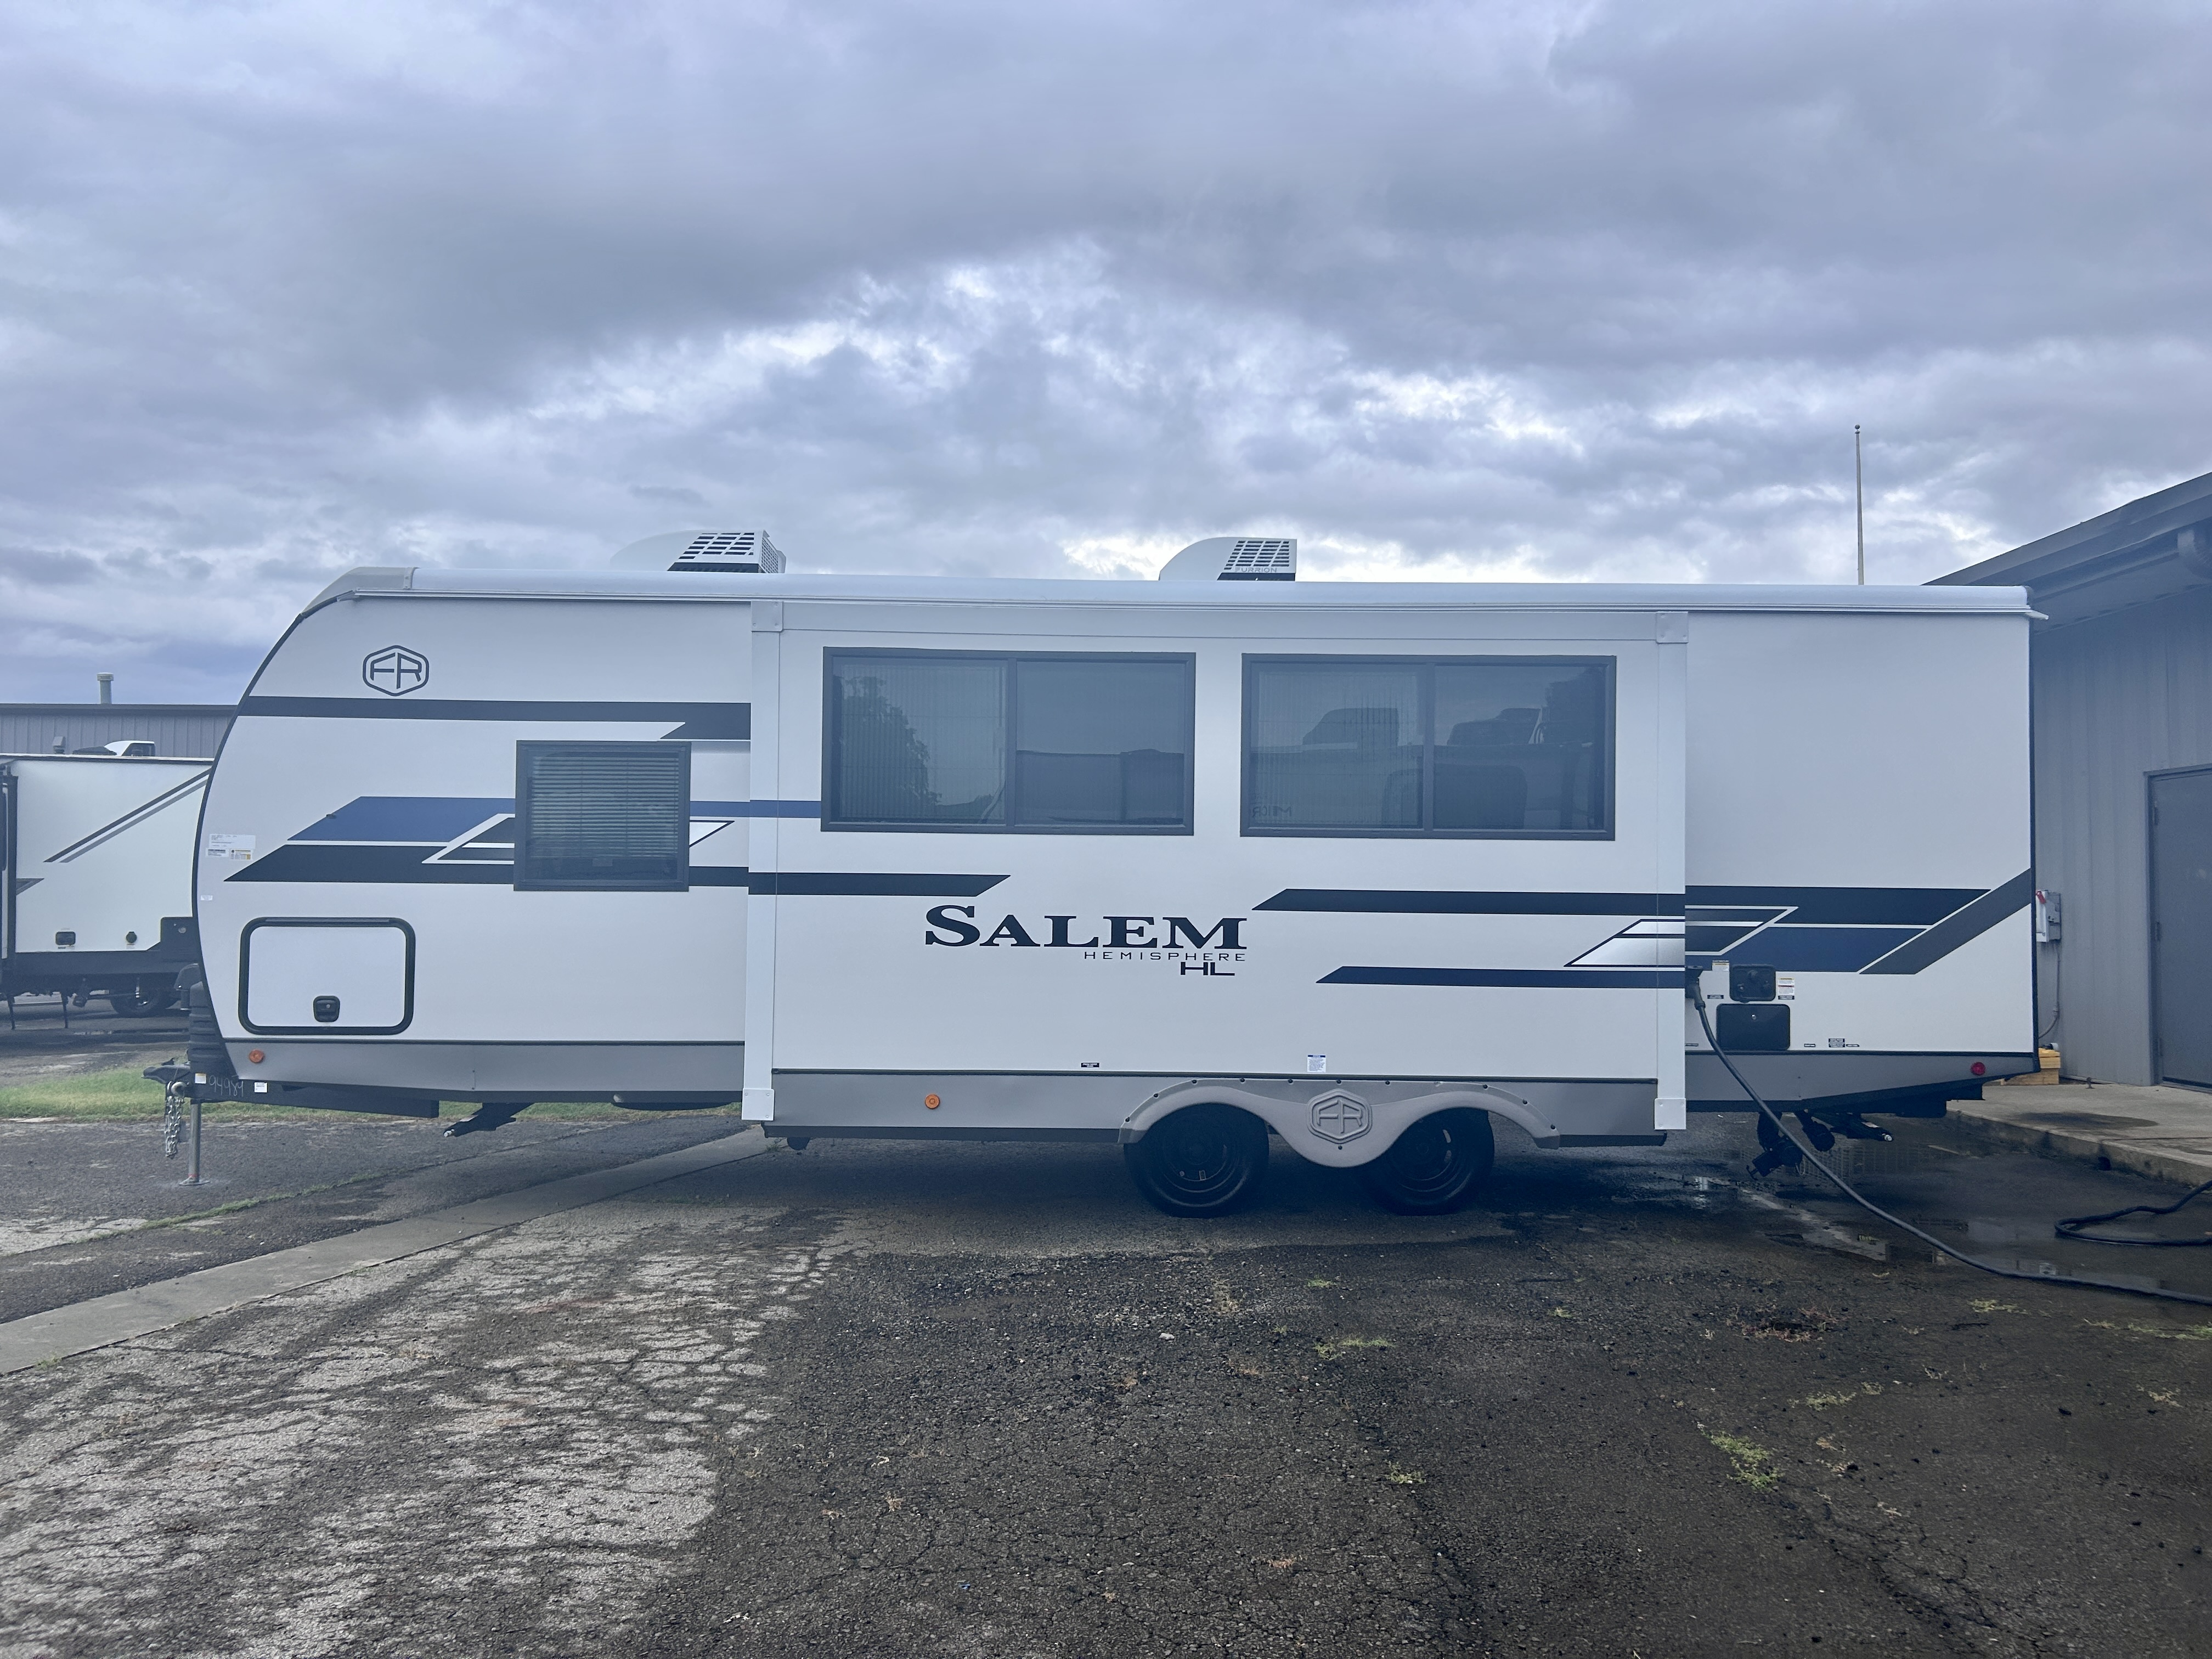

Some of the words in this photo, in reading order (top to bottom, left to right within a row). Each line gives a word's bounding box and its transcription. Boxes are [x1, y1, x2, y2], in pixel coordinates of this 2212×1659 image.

[370, 652, 422, 690] FR
[925, 905, 1247, 950] SALEM
[1084, 951, 1245, 961] HEMISPHERE
[1180, 962, 1235, 976] HL
